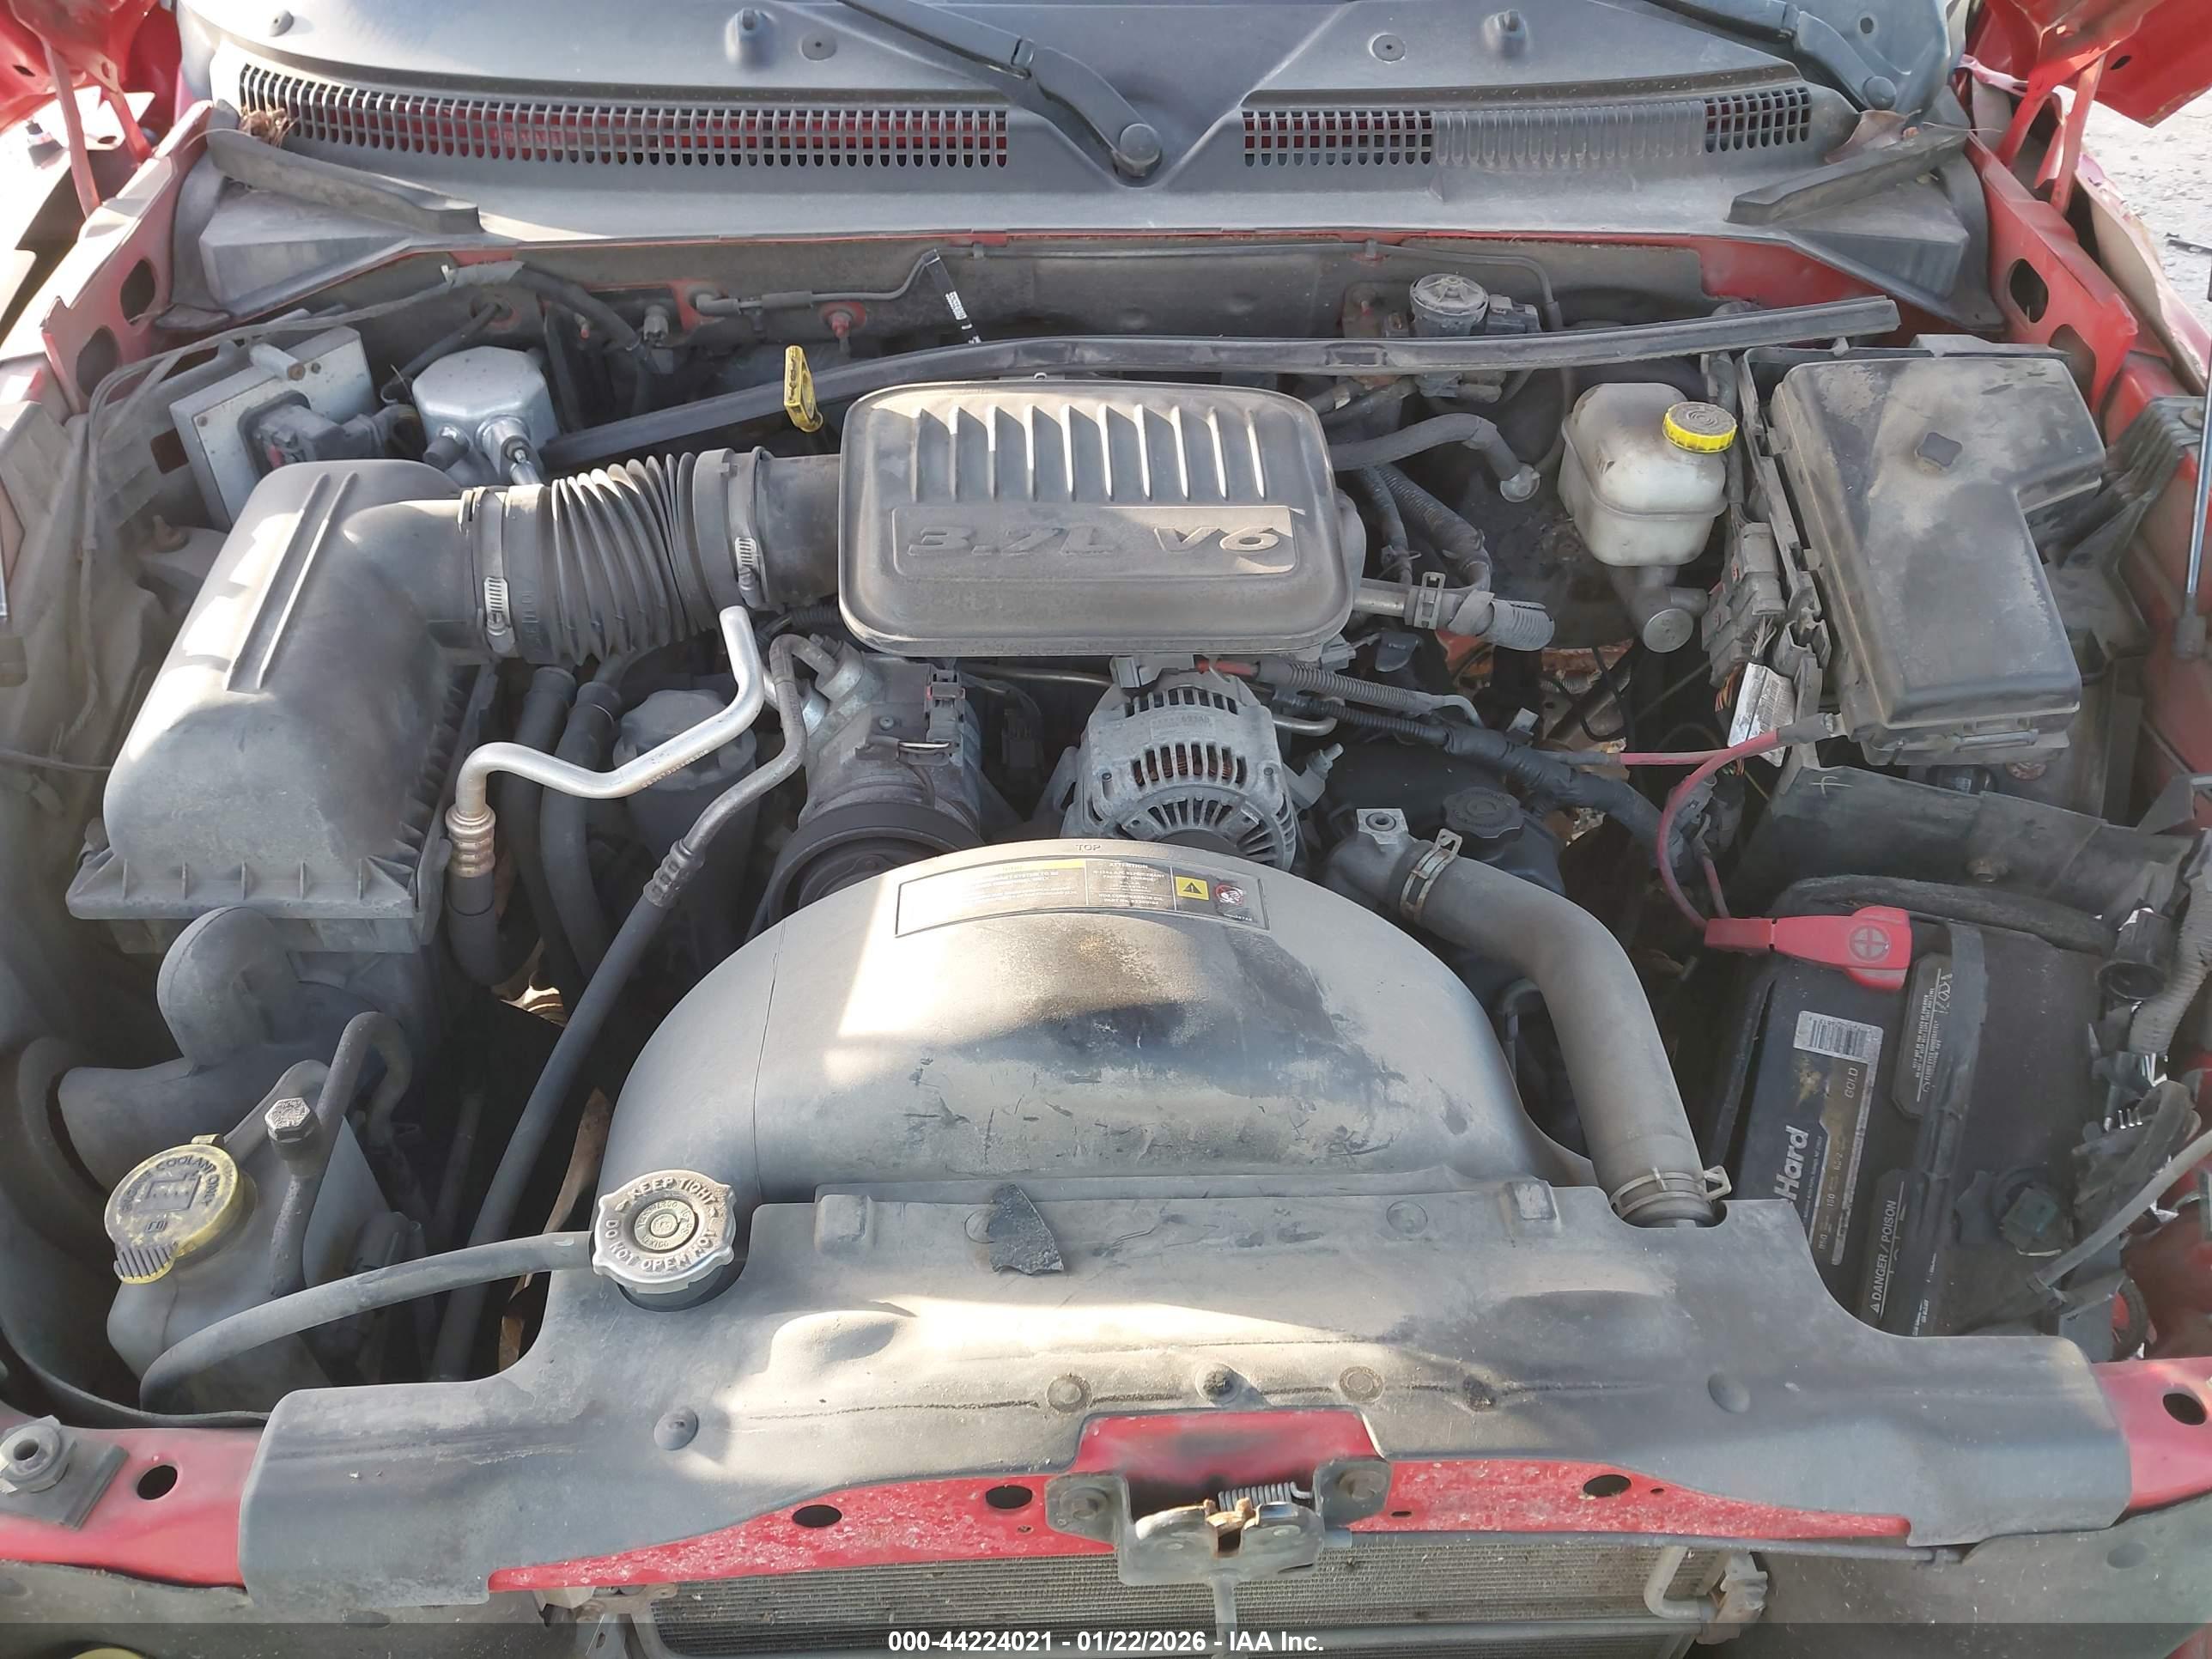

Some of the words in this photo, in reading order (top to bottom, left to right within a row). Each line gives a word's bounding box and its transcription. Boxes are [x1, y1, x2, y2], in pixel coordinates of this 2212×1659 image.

[1154, 525, 1280, 552] V6
[1844, 1066, 1859, 1098] GOLD
[156, 1155, 217, 1175] COOLANT
[201, 1174, 221, 1206] ONLY
[628, 1176, 677, 1200] KEEP
[679, 1177, 718, 1206] TIGHT
[605, 1219, 619, 1240] DO
[610, 1241, 640, 1266] NOT
[641, 1254, 692, 1273] OPEN
[1871, 1253, 1888, 1301] DANGER
[1881, 1200, 1897, 1243] POISON
